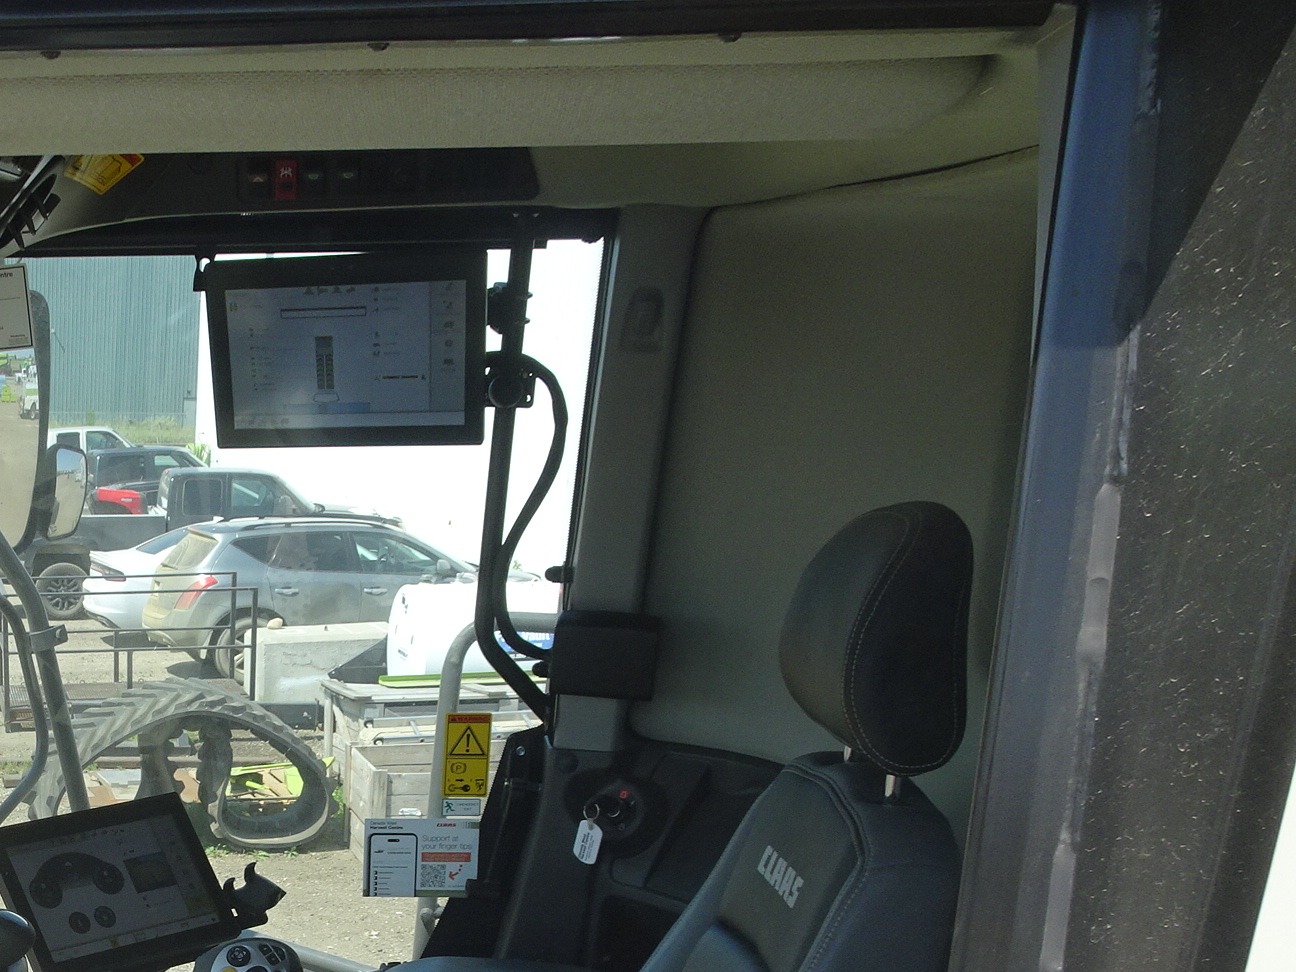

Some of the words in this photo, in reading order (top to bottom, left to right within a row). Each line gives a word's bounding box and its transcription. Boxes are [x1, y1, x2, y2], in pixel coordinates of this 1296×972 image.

[422, 835, 450, 843] Support
[438, 842, 458, 851] finger
[757, 845, 804, 909] CLAAS
